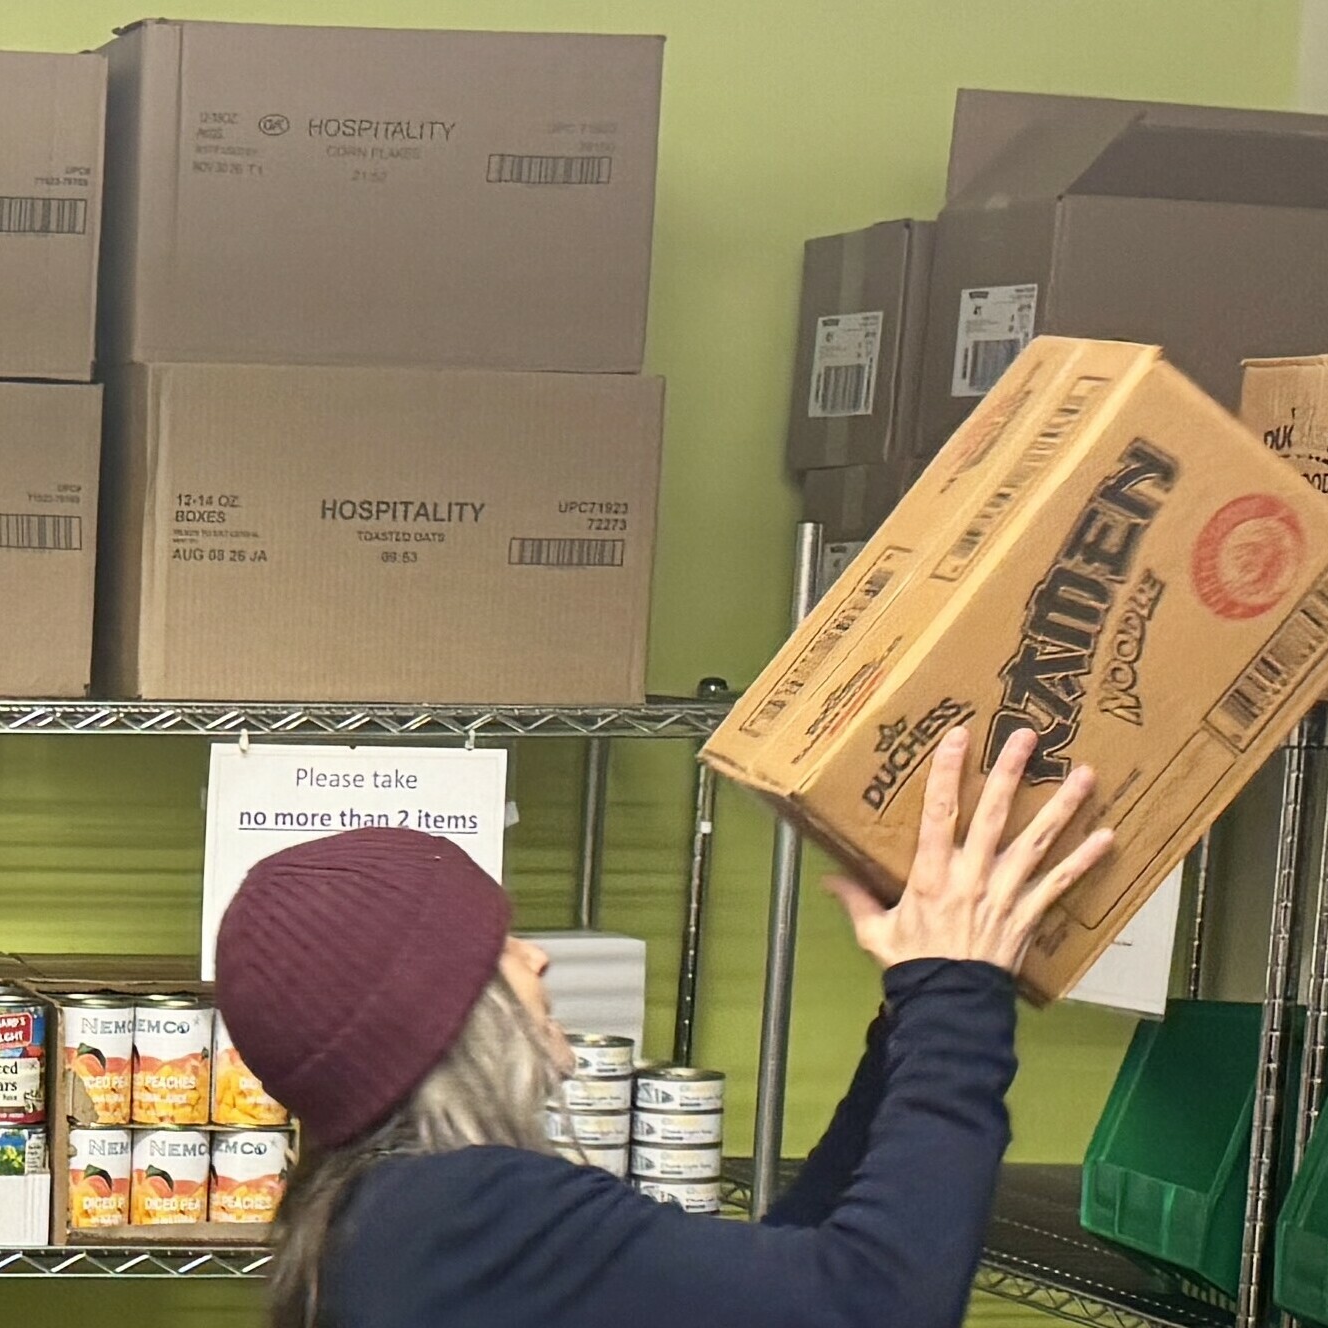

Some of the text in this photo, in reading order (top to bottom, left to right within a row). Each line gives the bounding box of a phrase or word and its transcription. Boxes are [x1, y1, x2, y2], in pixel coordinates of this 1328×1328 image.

[308, 118, 456, 142] HOSPITALITY
[174, 509, 226, 524] BOXES
[320, 499, 485, 524] HOSPITALITY
[586, 517, 628, 531] 72273
[172, 548, 204, 562] AUG
[980, 438, 1177, 787] RAMEN
[1101, 567, 1166, 727] NOODLE
[863, 696, 971, 812] DUCHESS
[295, 767, 419, 790] Please take
[238, 807, 479, 831] no more than 2 items
[146, 1075, 197, 1091] PEACHES
